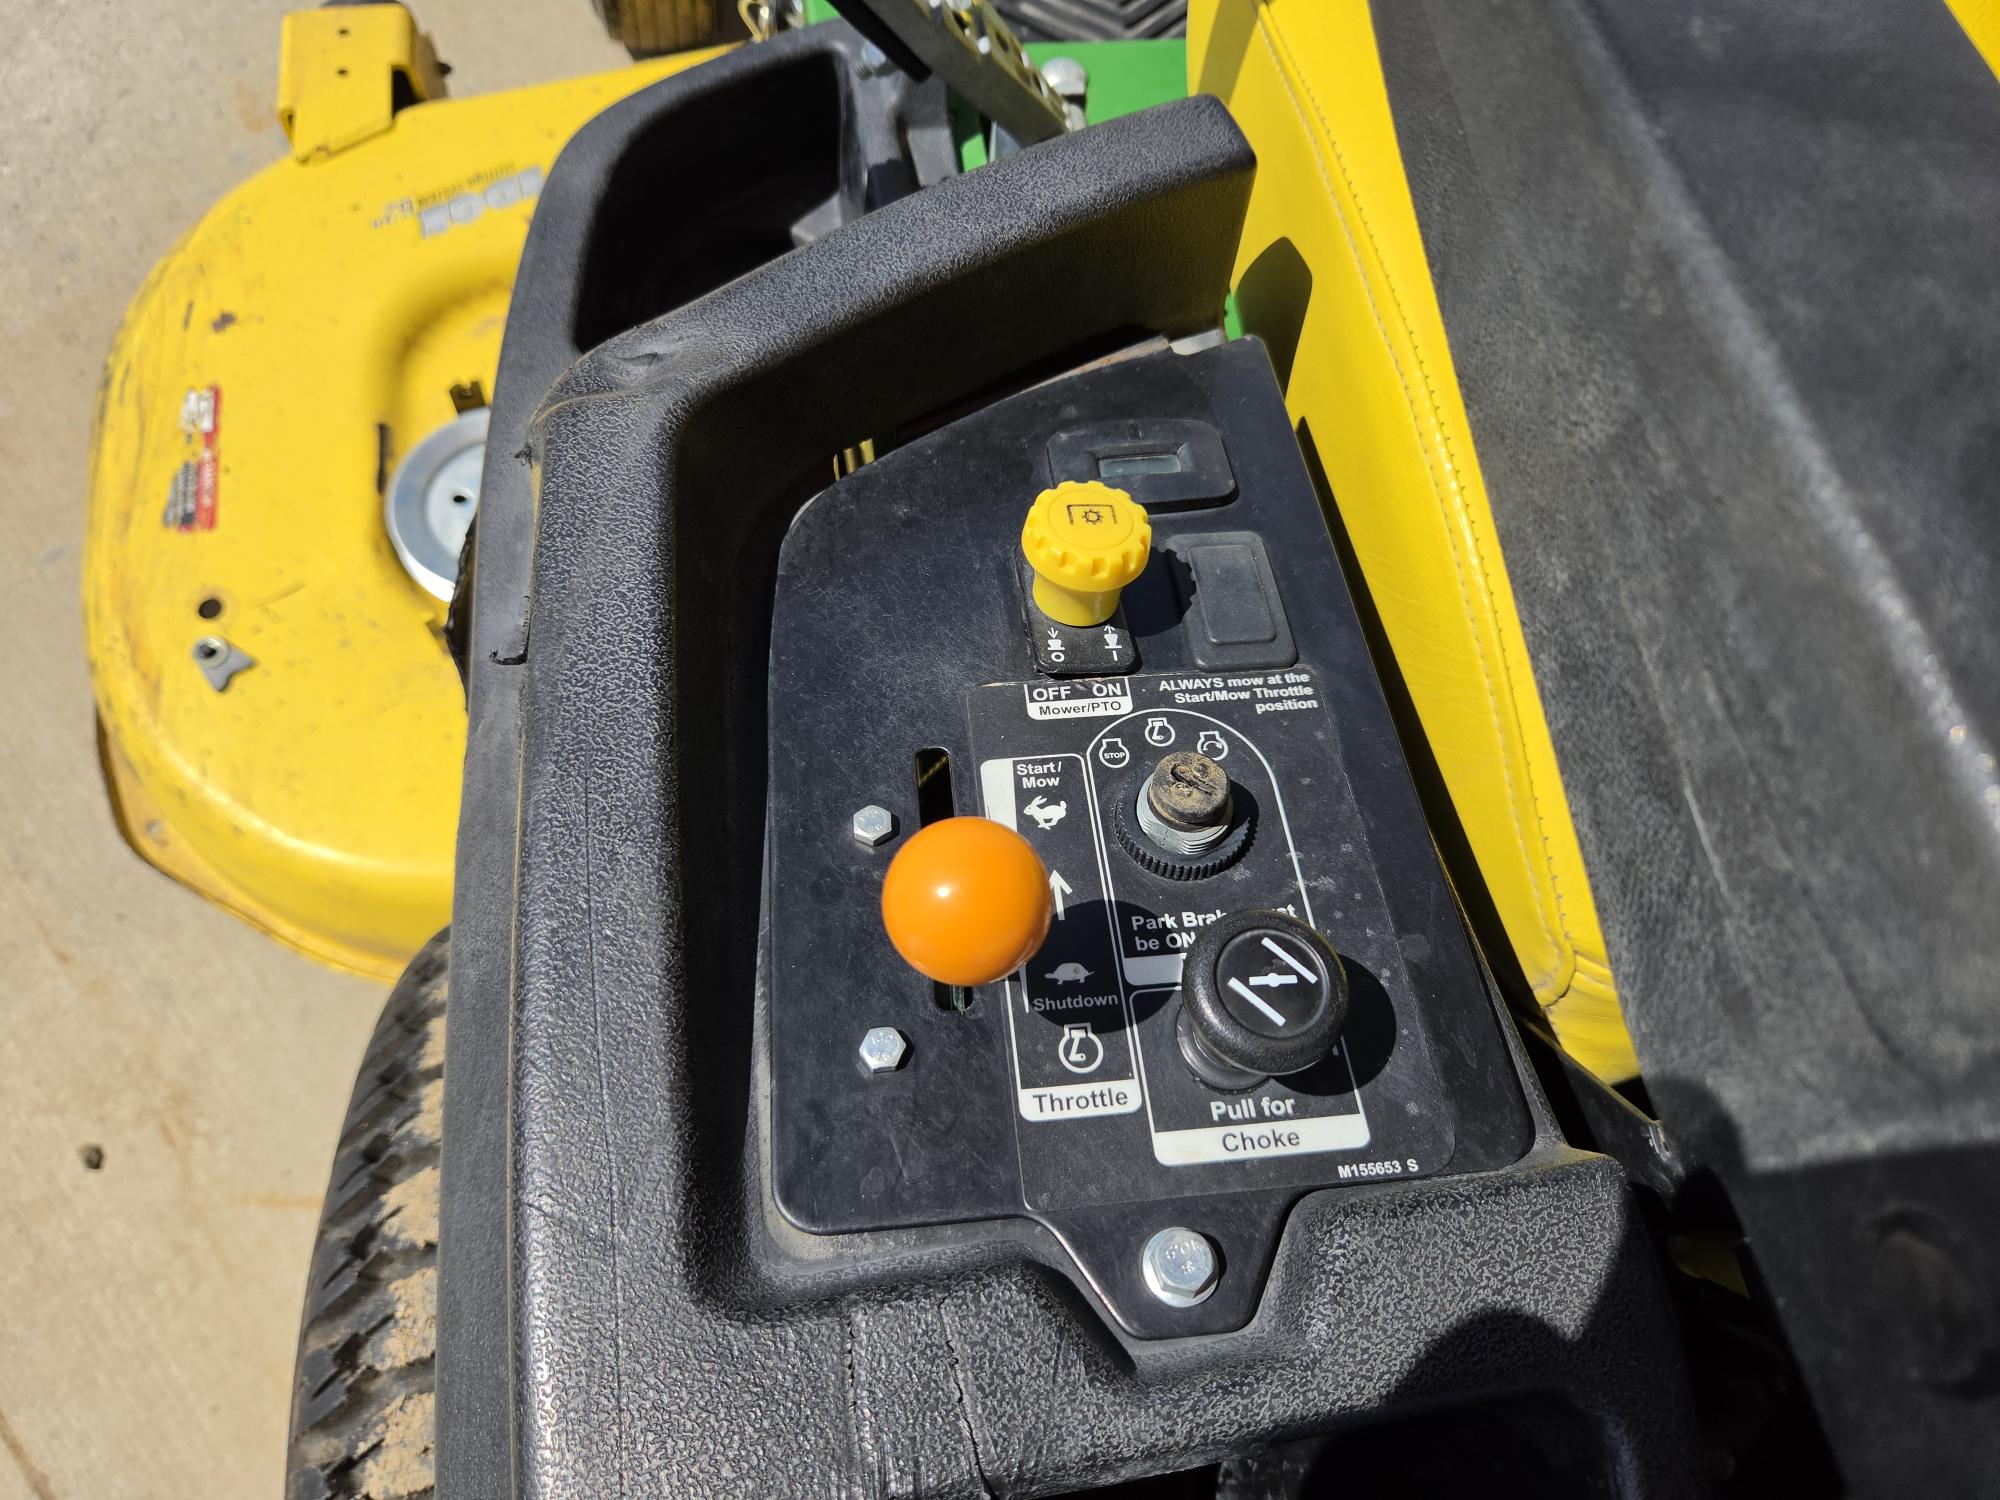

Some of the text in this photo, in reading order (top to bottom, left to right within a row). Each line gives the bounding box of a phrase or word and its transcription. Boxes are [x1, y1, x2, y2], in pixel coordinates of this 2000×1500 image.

[1033, 682, 1122, 702] OFF ON
[1159, 672, 1310, 692] ALWAYS mow at the
[1175, 685, 1314, 704] Start/Mow Throttle
[1039, 700, 1121, 717] Mower/PTO
[1256, 698, 1318, 715] position
[1103, 751, 1126, 760] STOP
[1016, 761, 1062, 776] Start/
[1022, 774, 1060, 789] Mow
[1131, 909, 1227, 931] Park Brak
[1135, 936, 1159, 951] be
[1033, 992, 1119, 1012] Shutdown
[1033, 1089, 1129, 1115] Throttle
[1210, 1096, 1295, 1121] Pull for
[1221, 1129, 1300, 1153] Choke
[1337, 1159, 1419, 1179] M155653 S
